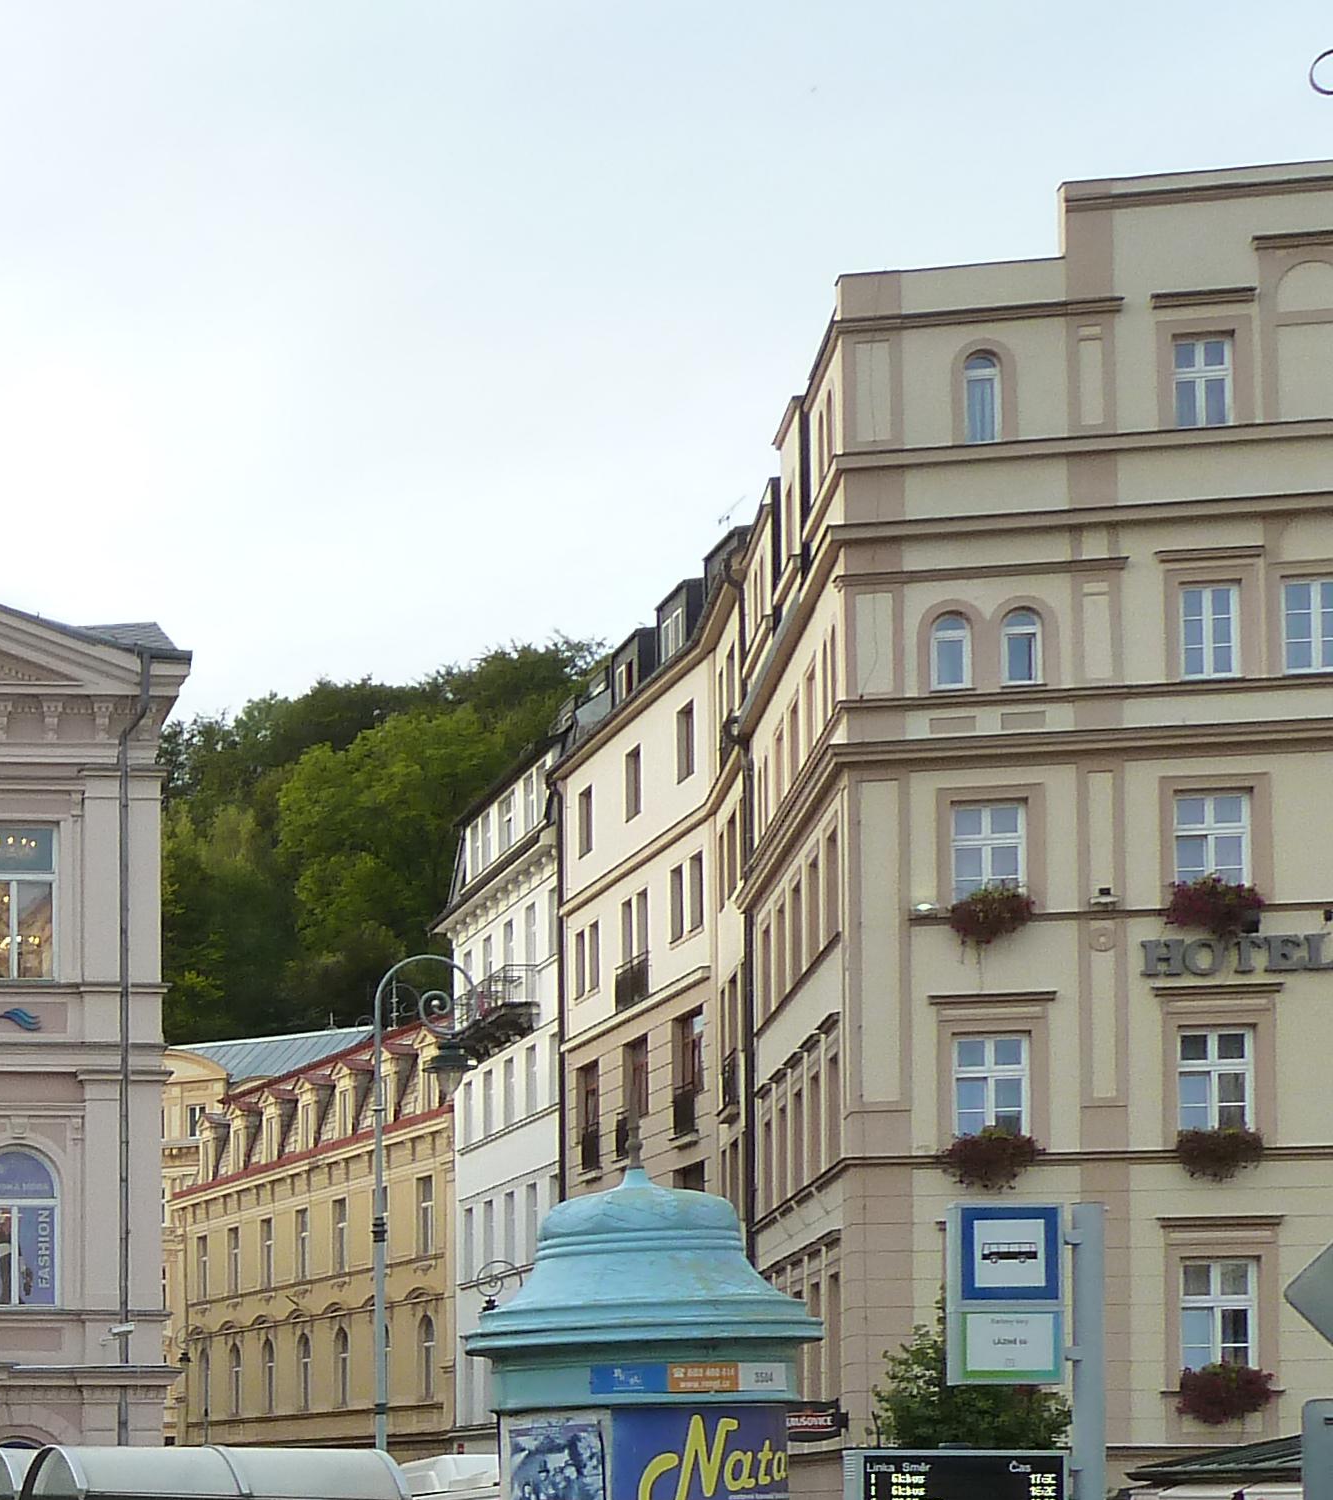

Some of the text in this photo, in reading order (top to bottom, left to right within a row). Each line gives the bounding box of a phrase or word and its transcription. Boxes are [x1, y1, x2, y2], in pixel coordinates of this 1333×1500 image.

[1140, 932, 1333, 976] HOTEL
[38, 1209, 51, 1288] FASHION
[866, 1460, 1032, 1473] Linka Směr Čas
